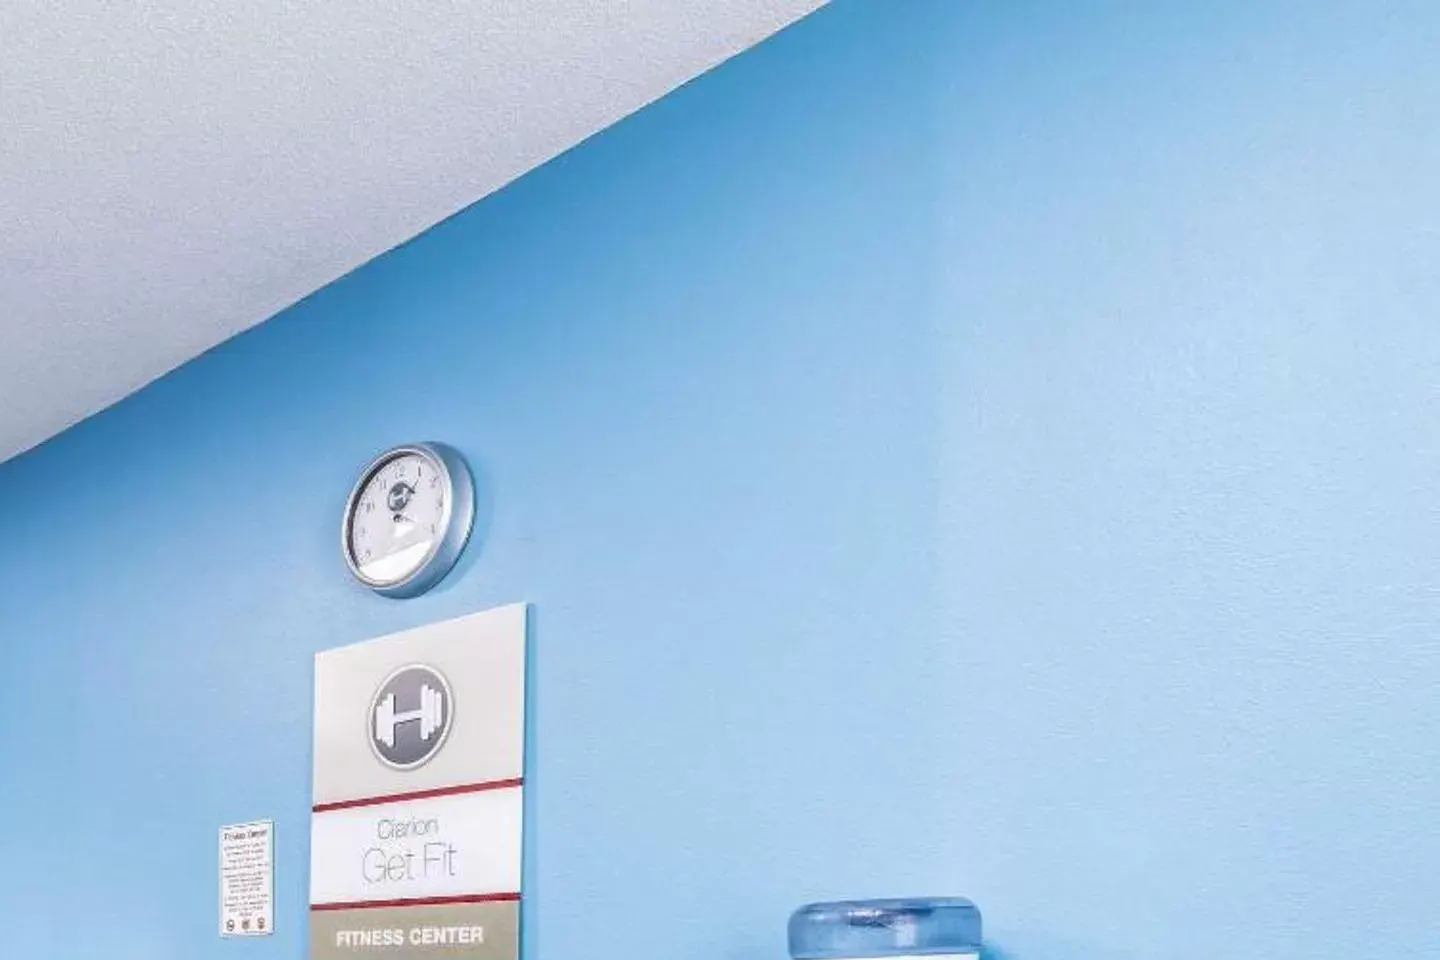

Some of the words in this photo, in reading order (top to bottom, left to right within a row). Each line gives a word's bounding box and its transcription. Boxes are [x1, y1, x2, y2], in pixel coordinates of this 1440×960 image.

[377, 816, 439, 840] Clarion
[362, 847, 415, 884] Get
[424, 841, 457, 878] Fit
[336, 929, 404, 948] FITNESS
[409, 926, 484, 946] CENTER
